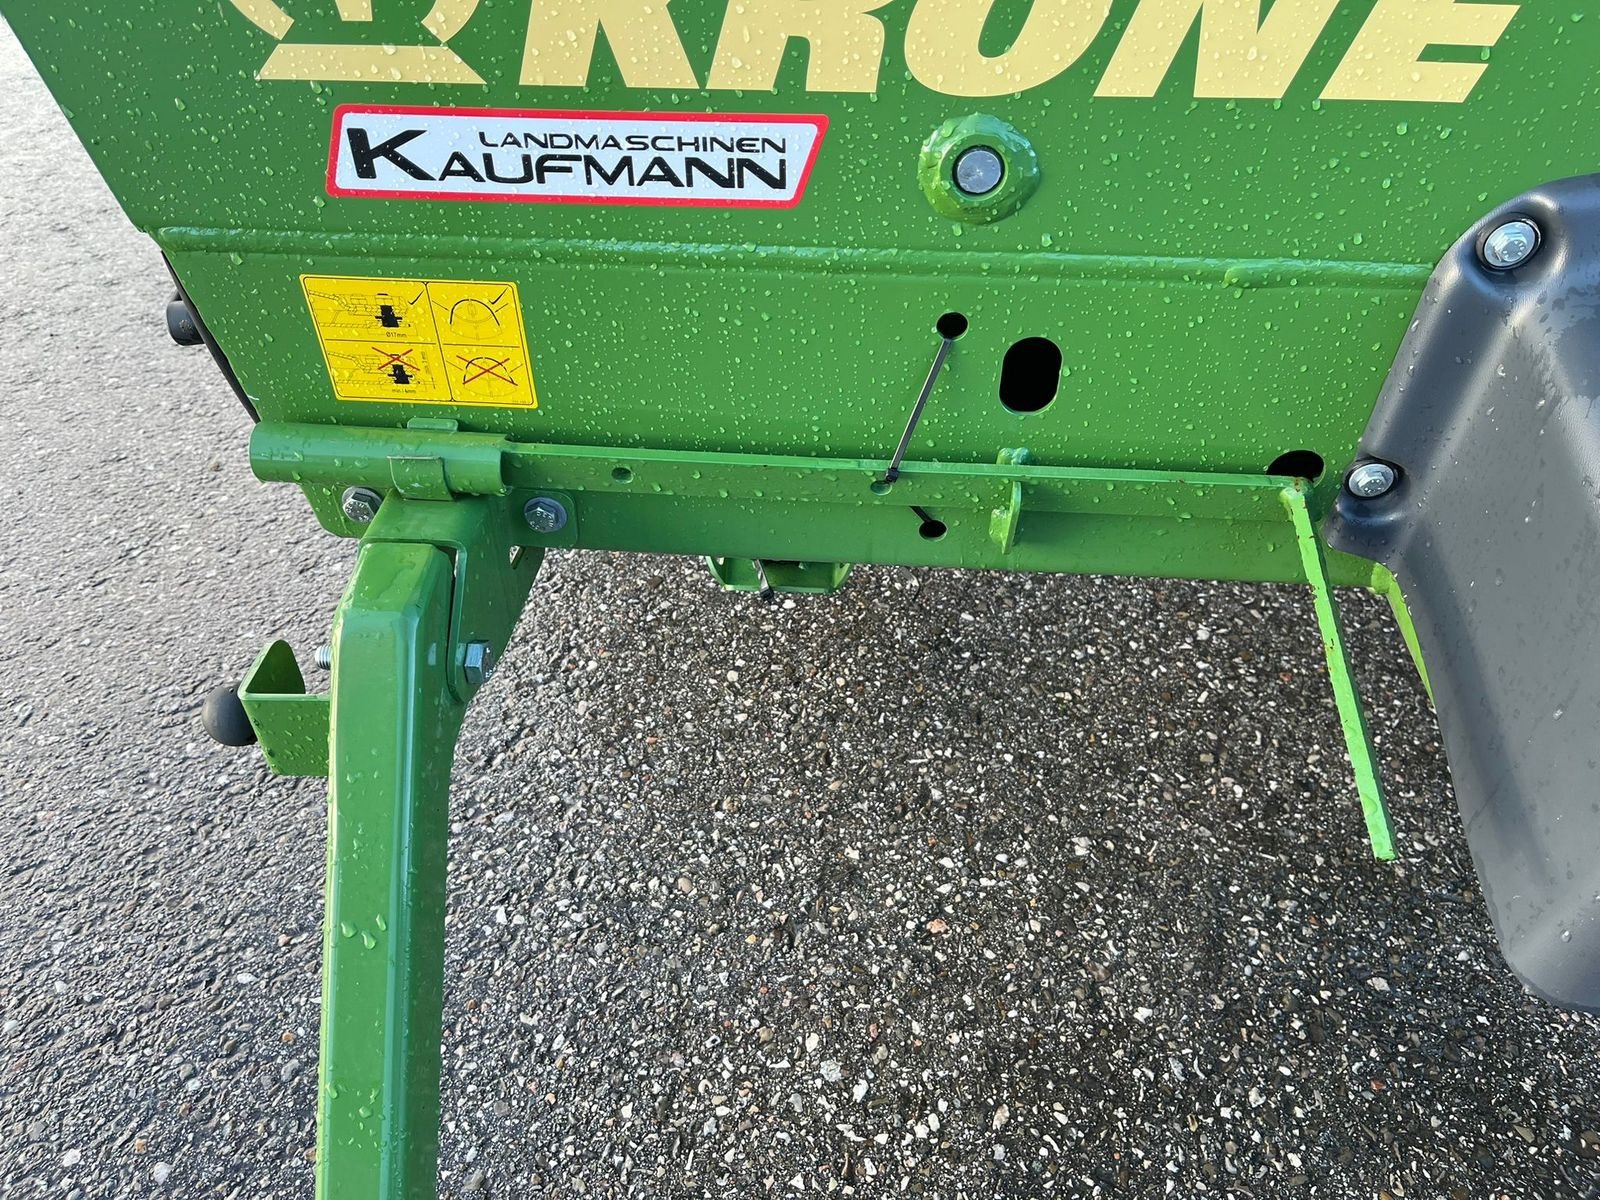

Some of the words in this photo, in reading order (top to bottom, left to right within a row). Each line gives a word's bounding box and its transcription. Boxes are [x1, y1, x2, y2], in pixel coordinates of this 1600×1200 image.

[518, 0, 1520, 103] KRONE
[346, 127, 788, 190] KAUFMANN
[478, 130, 787, 154] LANDMASCHINEN
